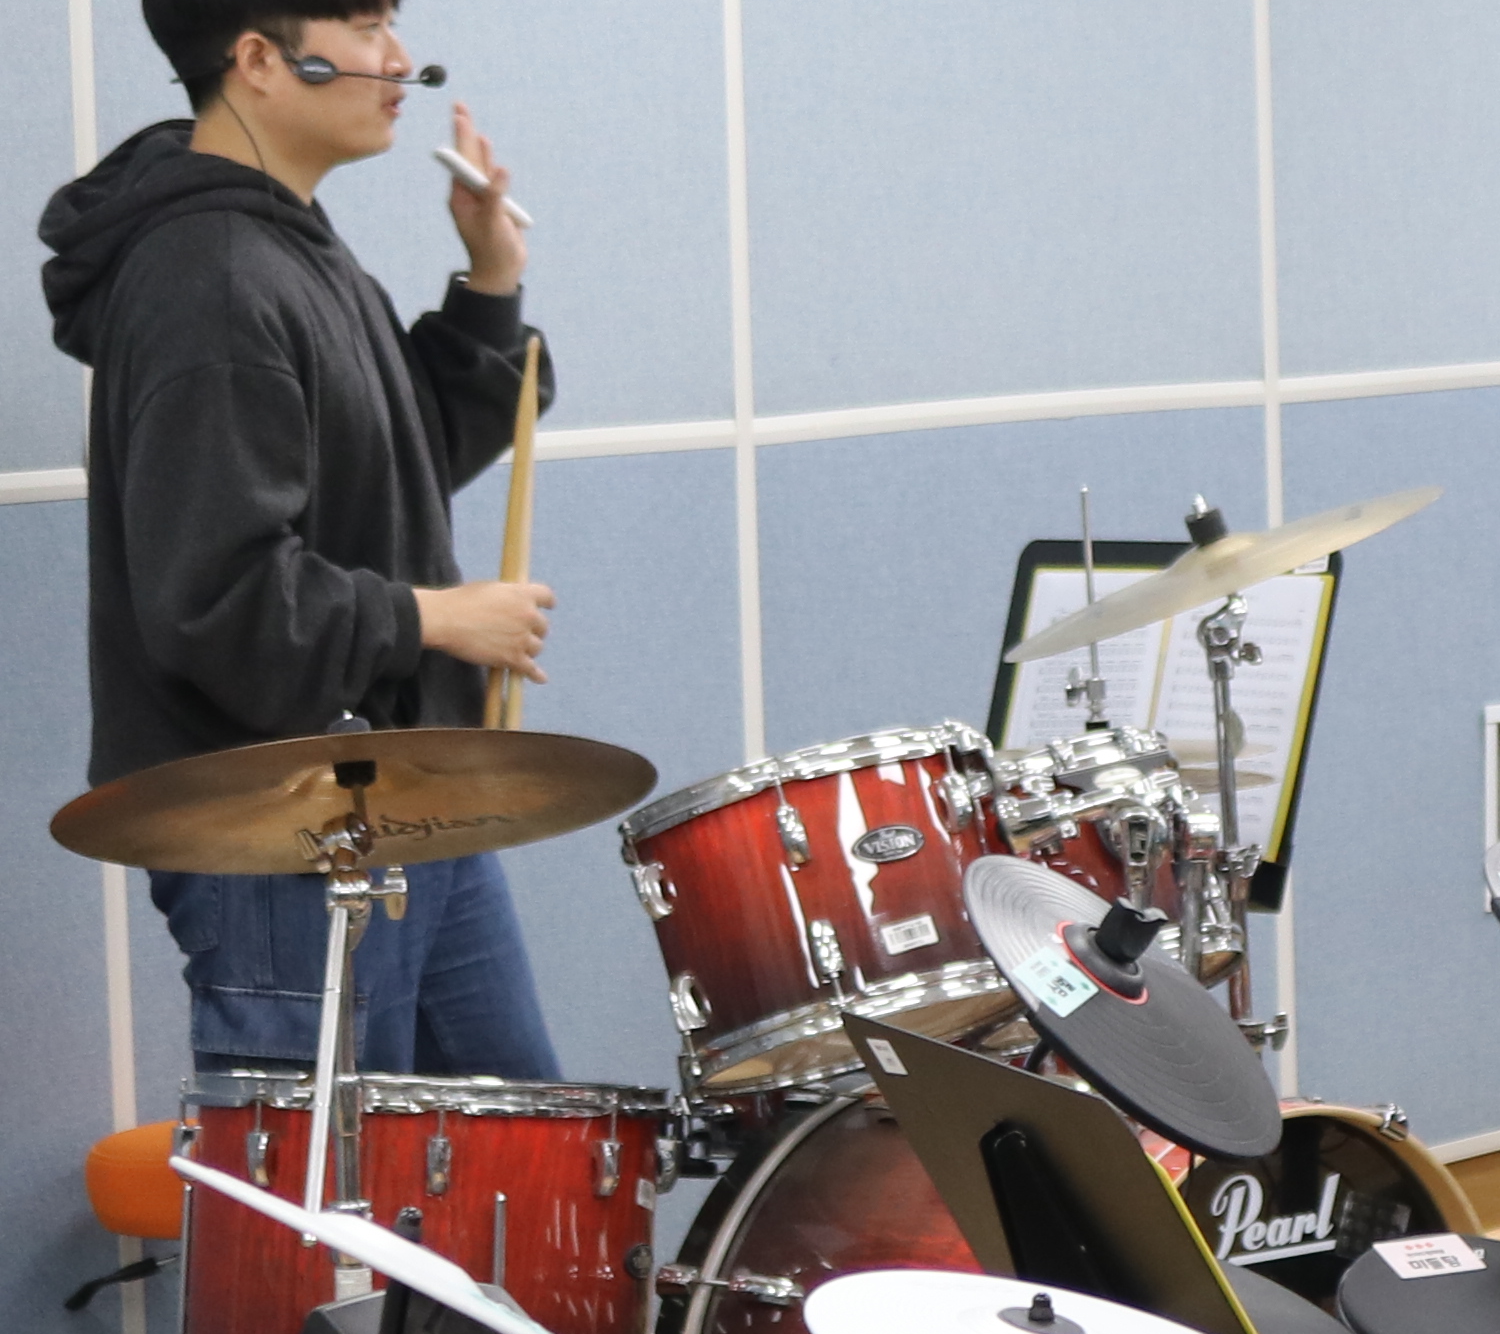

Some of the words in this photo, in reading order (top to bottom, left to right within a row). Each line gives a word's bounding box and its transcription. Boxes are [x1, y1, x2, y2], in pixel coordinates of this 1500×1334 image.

[863, 833, 917, 855] VISION
[1210, 1173, 1335, 1261] Pearl
[1407, 1255, 1462, 1271] 미들탐
